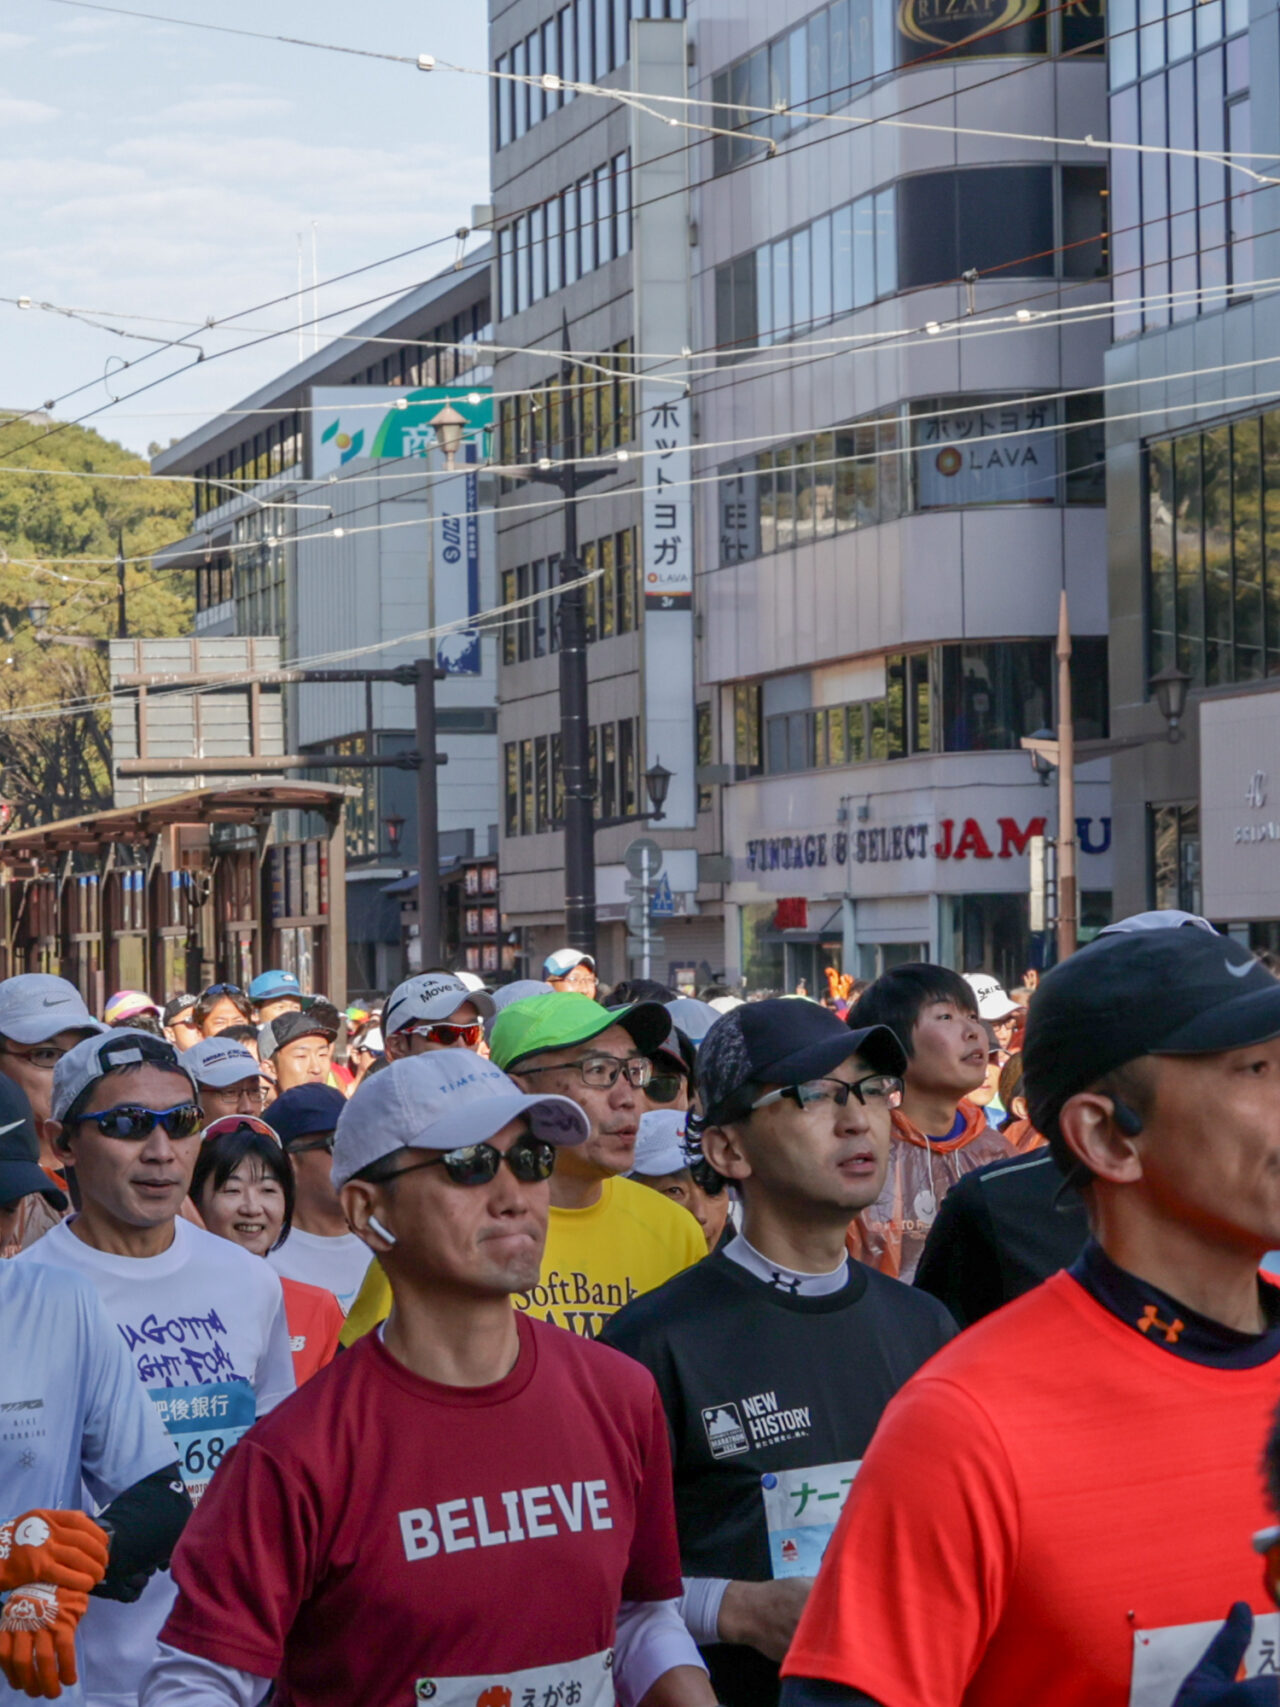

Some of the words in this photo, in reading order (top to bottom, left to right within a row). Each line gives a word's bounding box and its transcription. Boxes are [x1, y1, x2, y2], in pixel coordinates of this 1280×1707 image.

[926, 405, 1048, 440] ホットヨガ
[969, 446, 1038, 470] LAVA
[651, 402, 682, 566] ホットヨガ
[747, 833, 827, 871] VINTAGE
[856, 823, 929, 863] SELECT
[934, 816, 1048, 860] JAM
[420, 984, 453, 1003] Move
[440, 1073, 477, 1094] TIME
[741, 1391, 778, 1418] NEW
[748, 1406, 812, 1440] HISTORY
[174, 1437, 225, 1474] 68
[790, 1479, 853, 1518] ナー
[399, 1480, 614, 1562] BELIEVE
[522, 1680, 582, 1707] えがお
